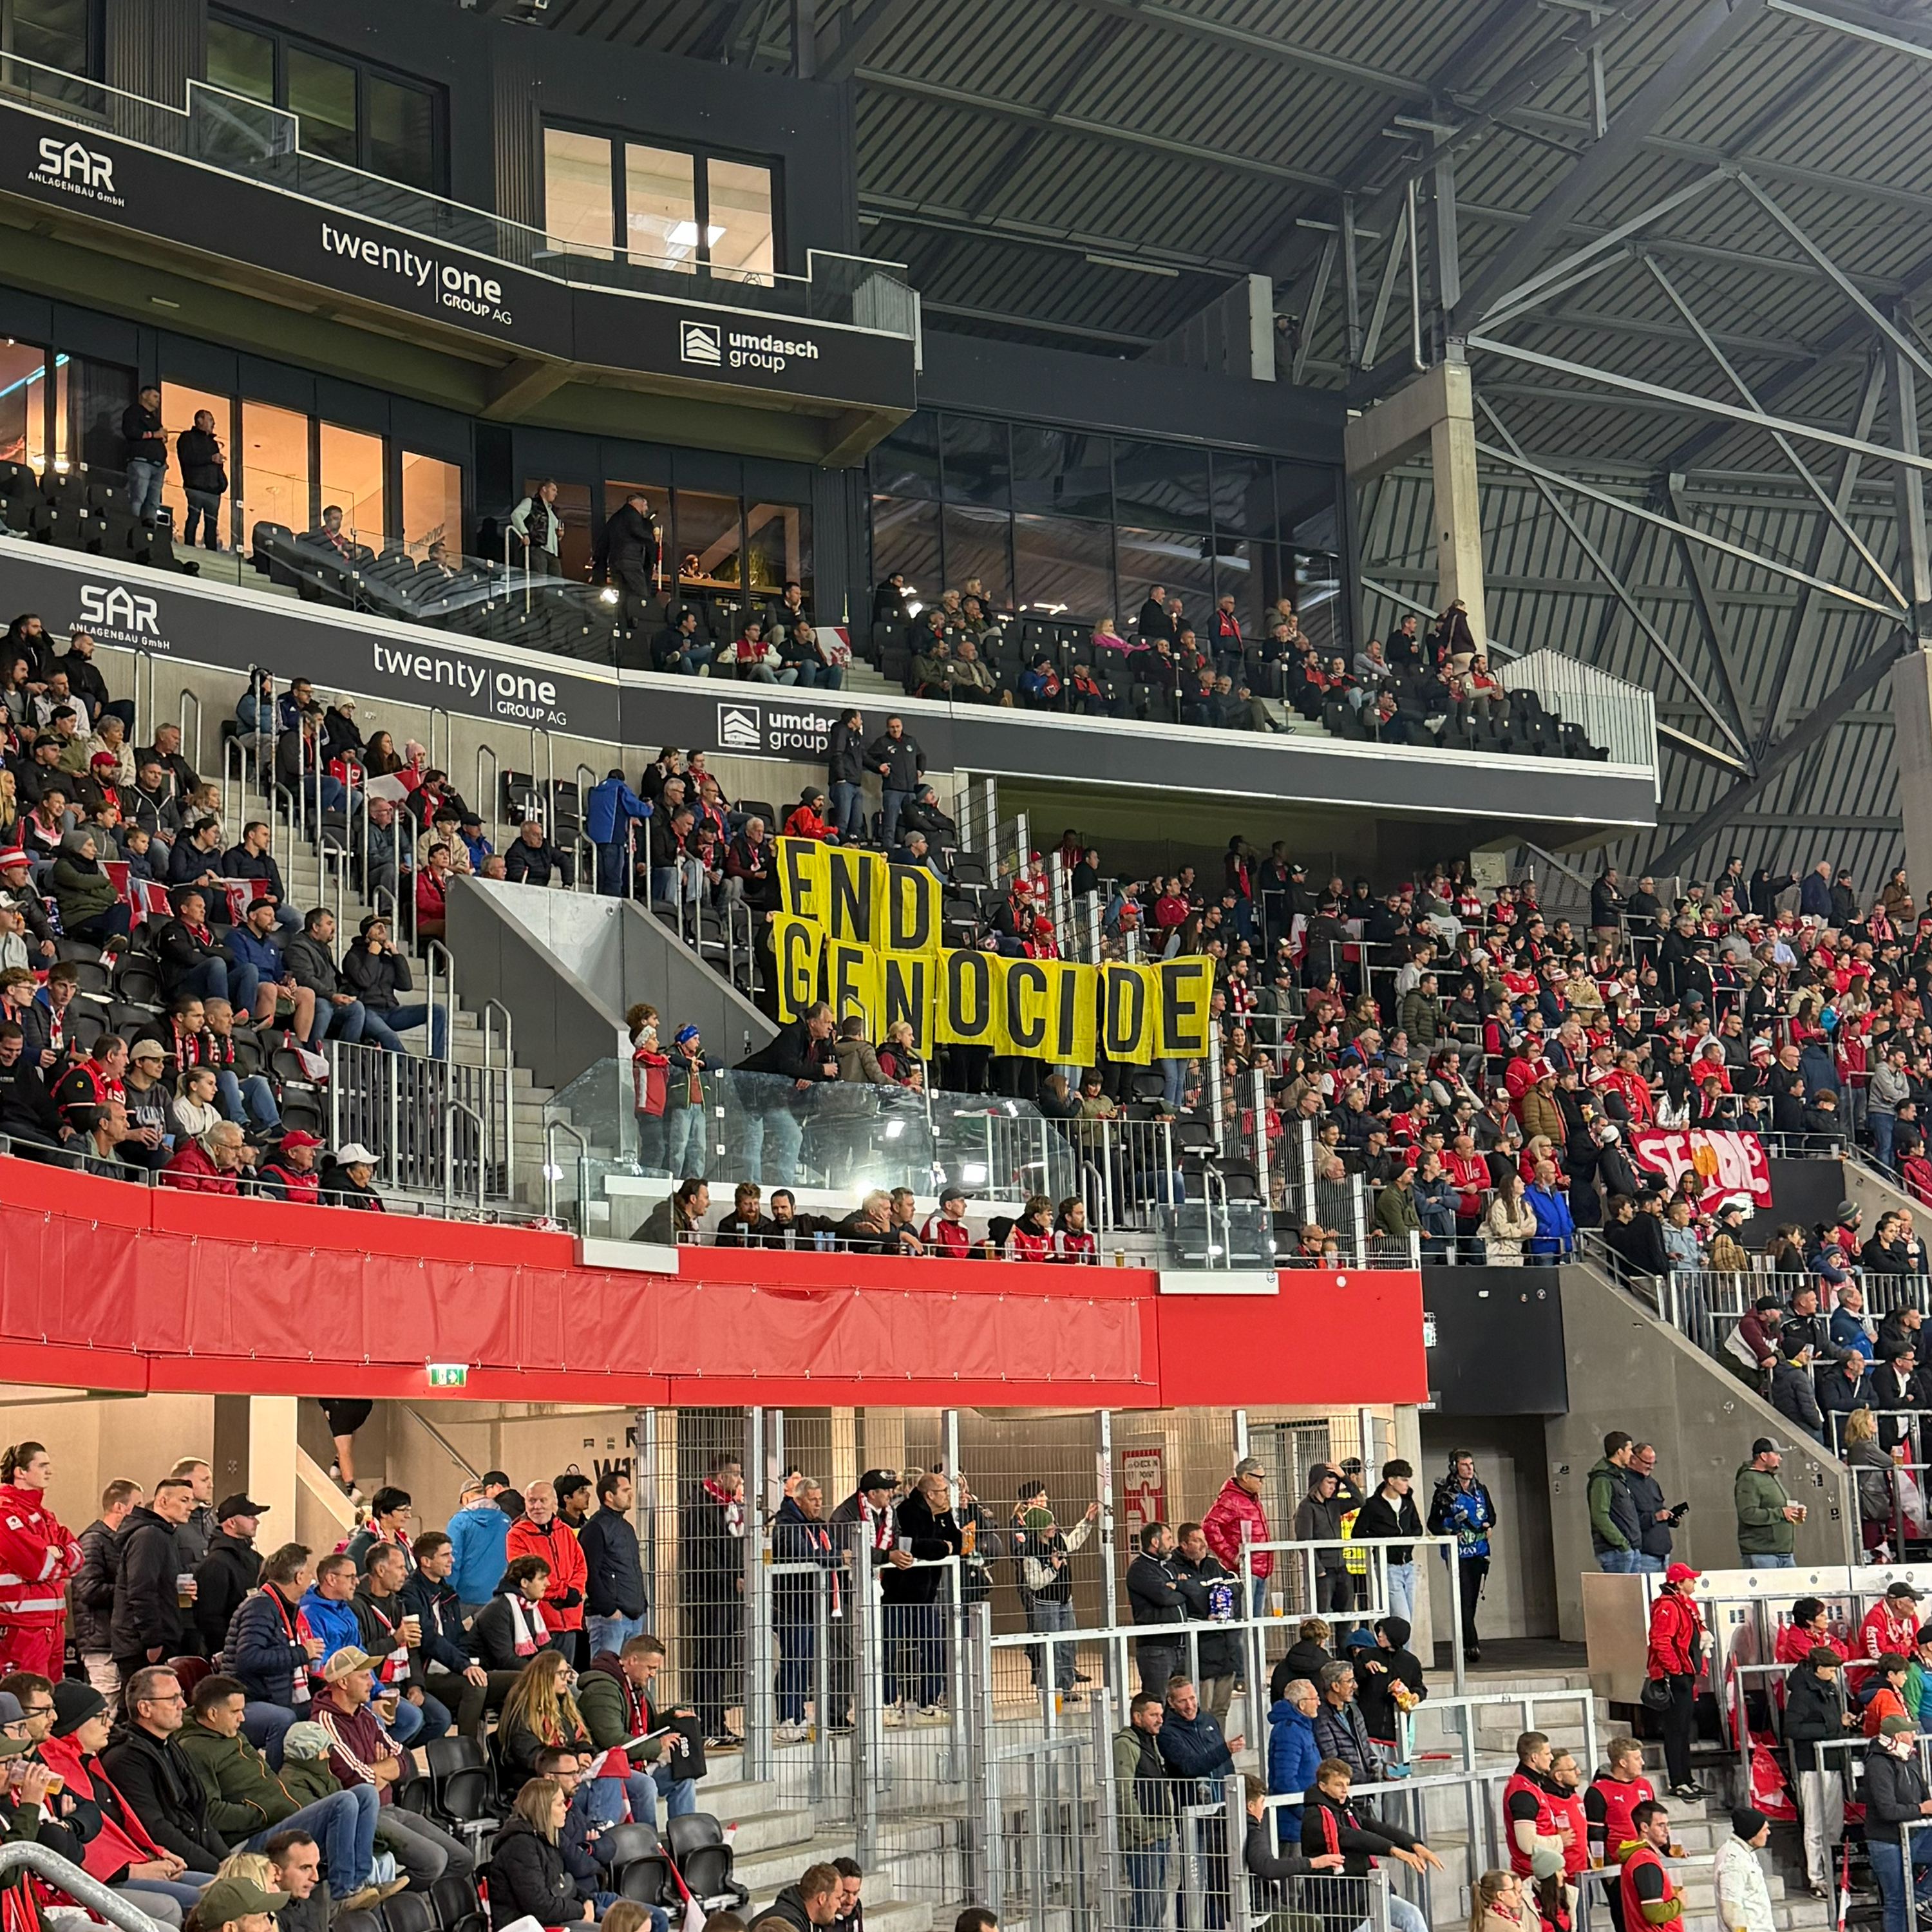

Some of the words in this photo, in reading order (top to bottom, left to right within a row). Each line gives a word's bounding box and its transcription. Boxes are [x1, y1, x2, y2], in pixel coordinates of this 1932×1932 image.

[38, 137, 115, 192] SAR
[28, 171, 94, 198] ANLAGENBAU
[97, 192, 124, 207] GmbH
[322, 223, 432, 287] twenty
[442, 266, 502, 304] one
[442, 293, 490, 316] GROUP
[492, 308, 512, 325] AG
[729, 332, 819, 359] umdasch
[730, 350, 786, 374] group
[80, 585, 160, 635] SAR
[69, 622, 138, 643] ANLAGENBAU
[142, 636, 170, 650] GmbH
[374, 643, 486, 697] twenty
[496, 673, 556, 705] one
[497, 701, 544, 720] GROUP
[547, 710, 567, 726] AG
[769, 732, 828, 753] group
[785, 839, 929, 949] END
[784, 922, 1202, 1056] GENOCIDE
